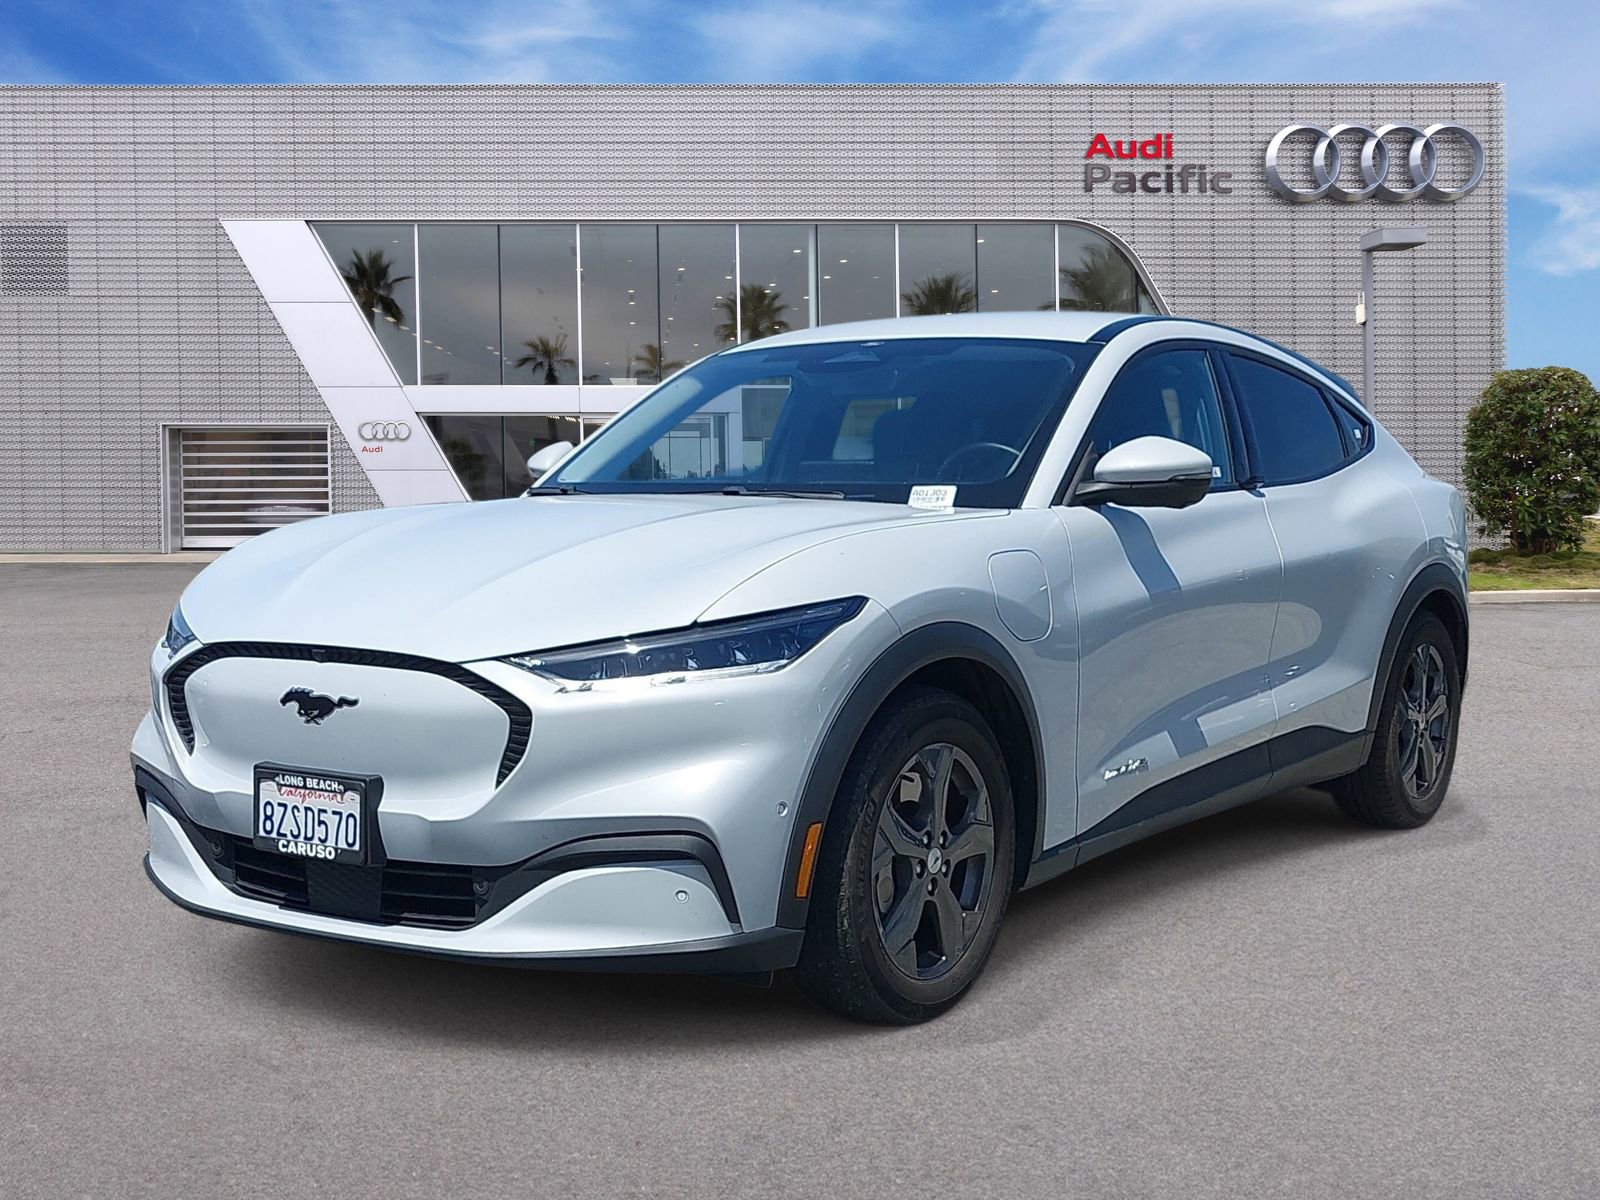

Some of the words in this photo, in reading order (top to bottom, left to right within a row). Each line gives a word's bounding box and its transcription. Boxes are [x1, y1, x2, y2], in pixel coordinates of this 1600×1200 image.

[1085, 133, 1173, 160] Audi
[1084, 163, 1233, 194] Pacific
[361, 445, 383, 453] Audi
[280, 774, 304, 787] LONG
[306, 777, 338, 792] BEACH
[262, 800, 358, 849] 8ZSD570
[278, 839, 336, 860] CARUSO
